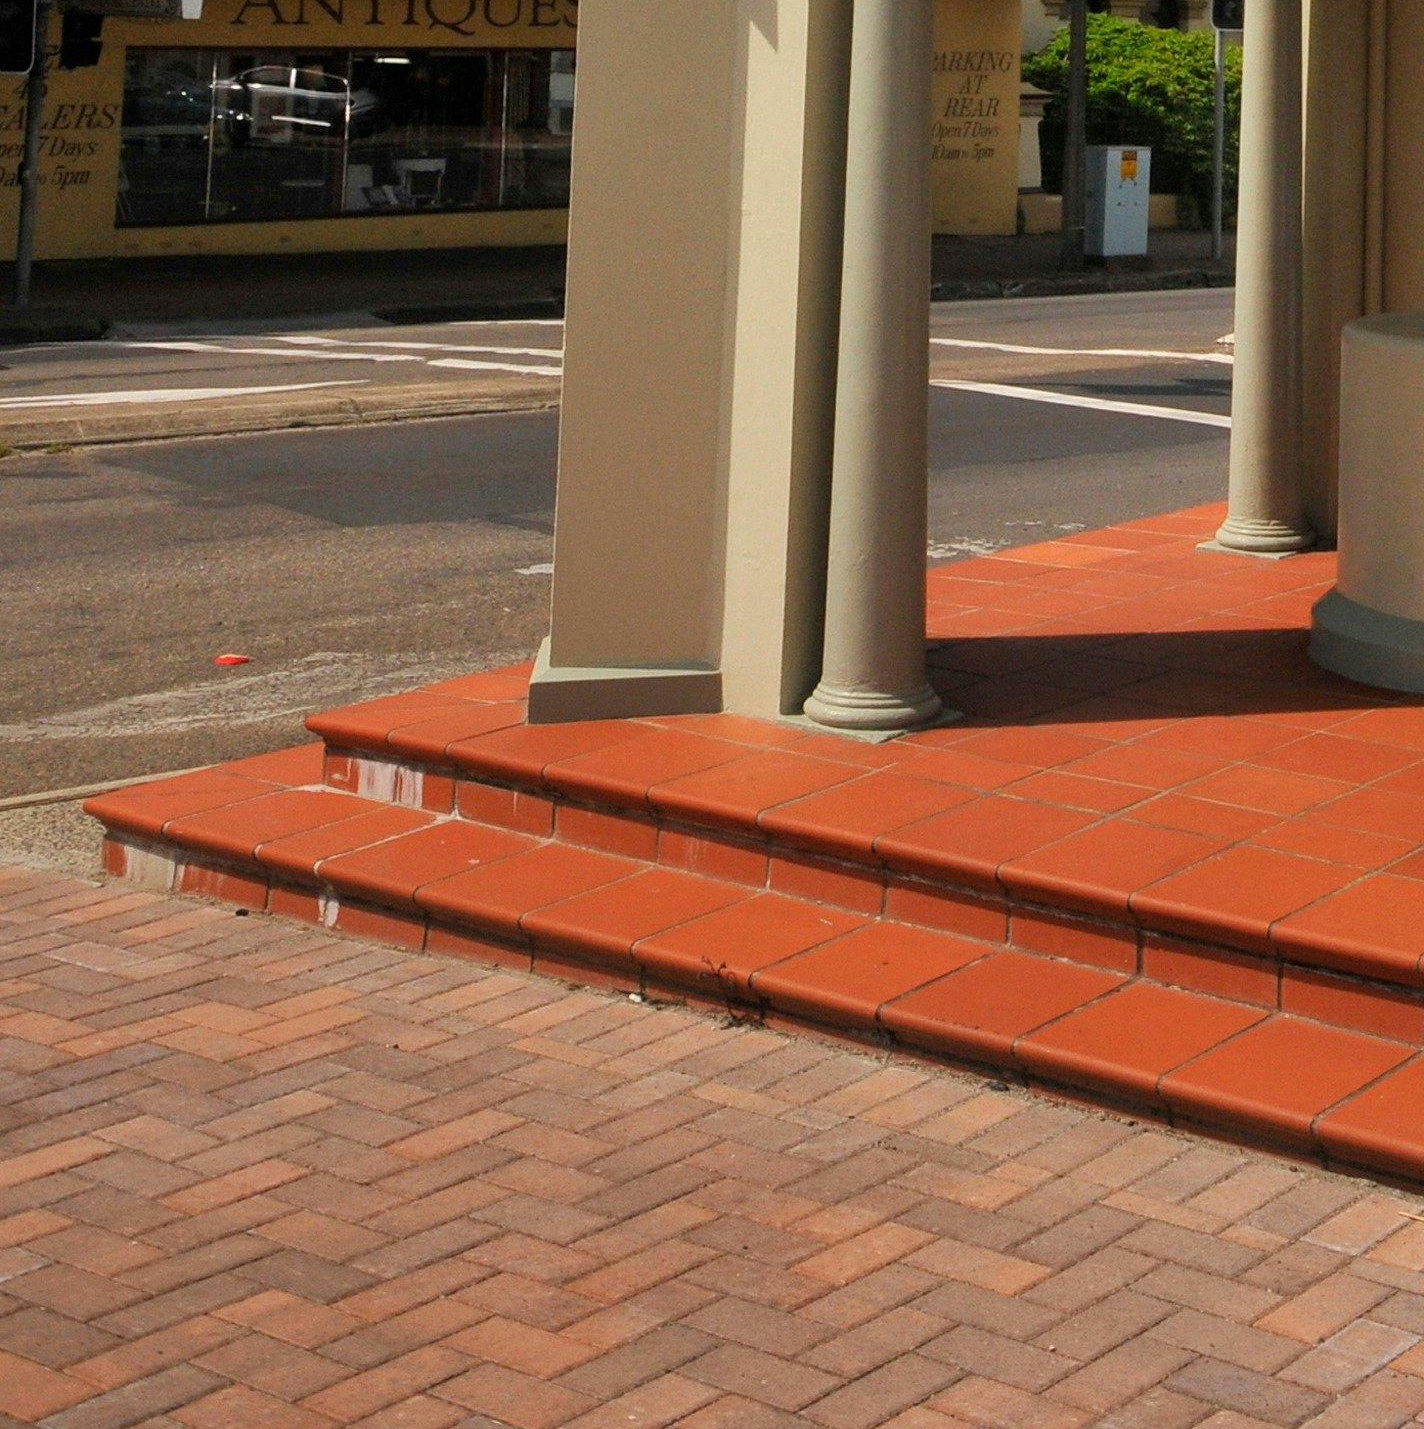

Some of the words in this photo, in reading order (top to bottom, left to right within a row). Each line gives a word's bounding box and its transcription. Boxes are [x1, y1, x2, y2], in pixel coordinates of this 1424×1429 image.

[959, 74, 988, 95] AT
[944, 97, 1001, 118] REAR
[48, 136, 98, 163] Days
[53, 166, 91, 190] 5pm
